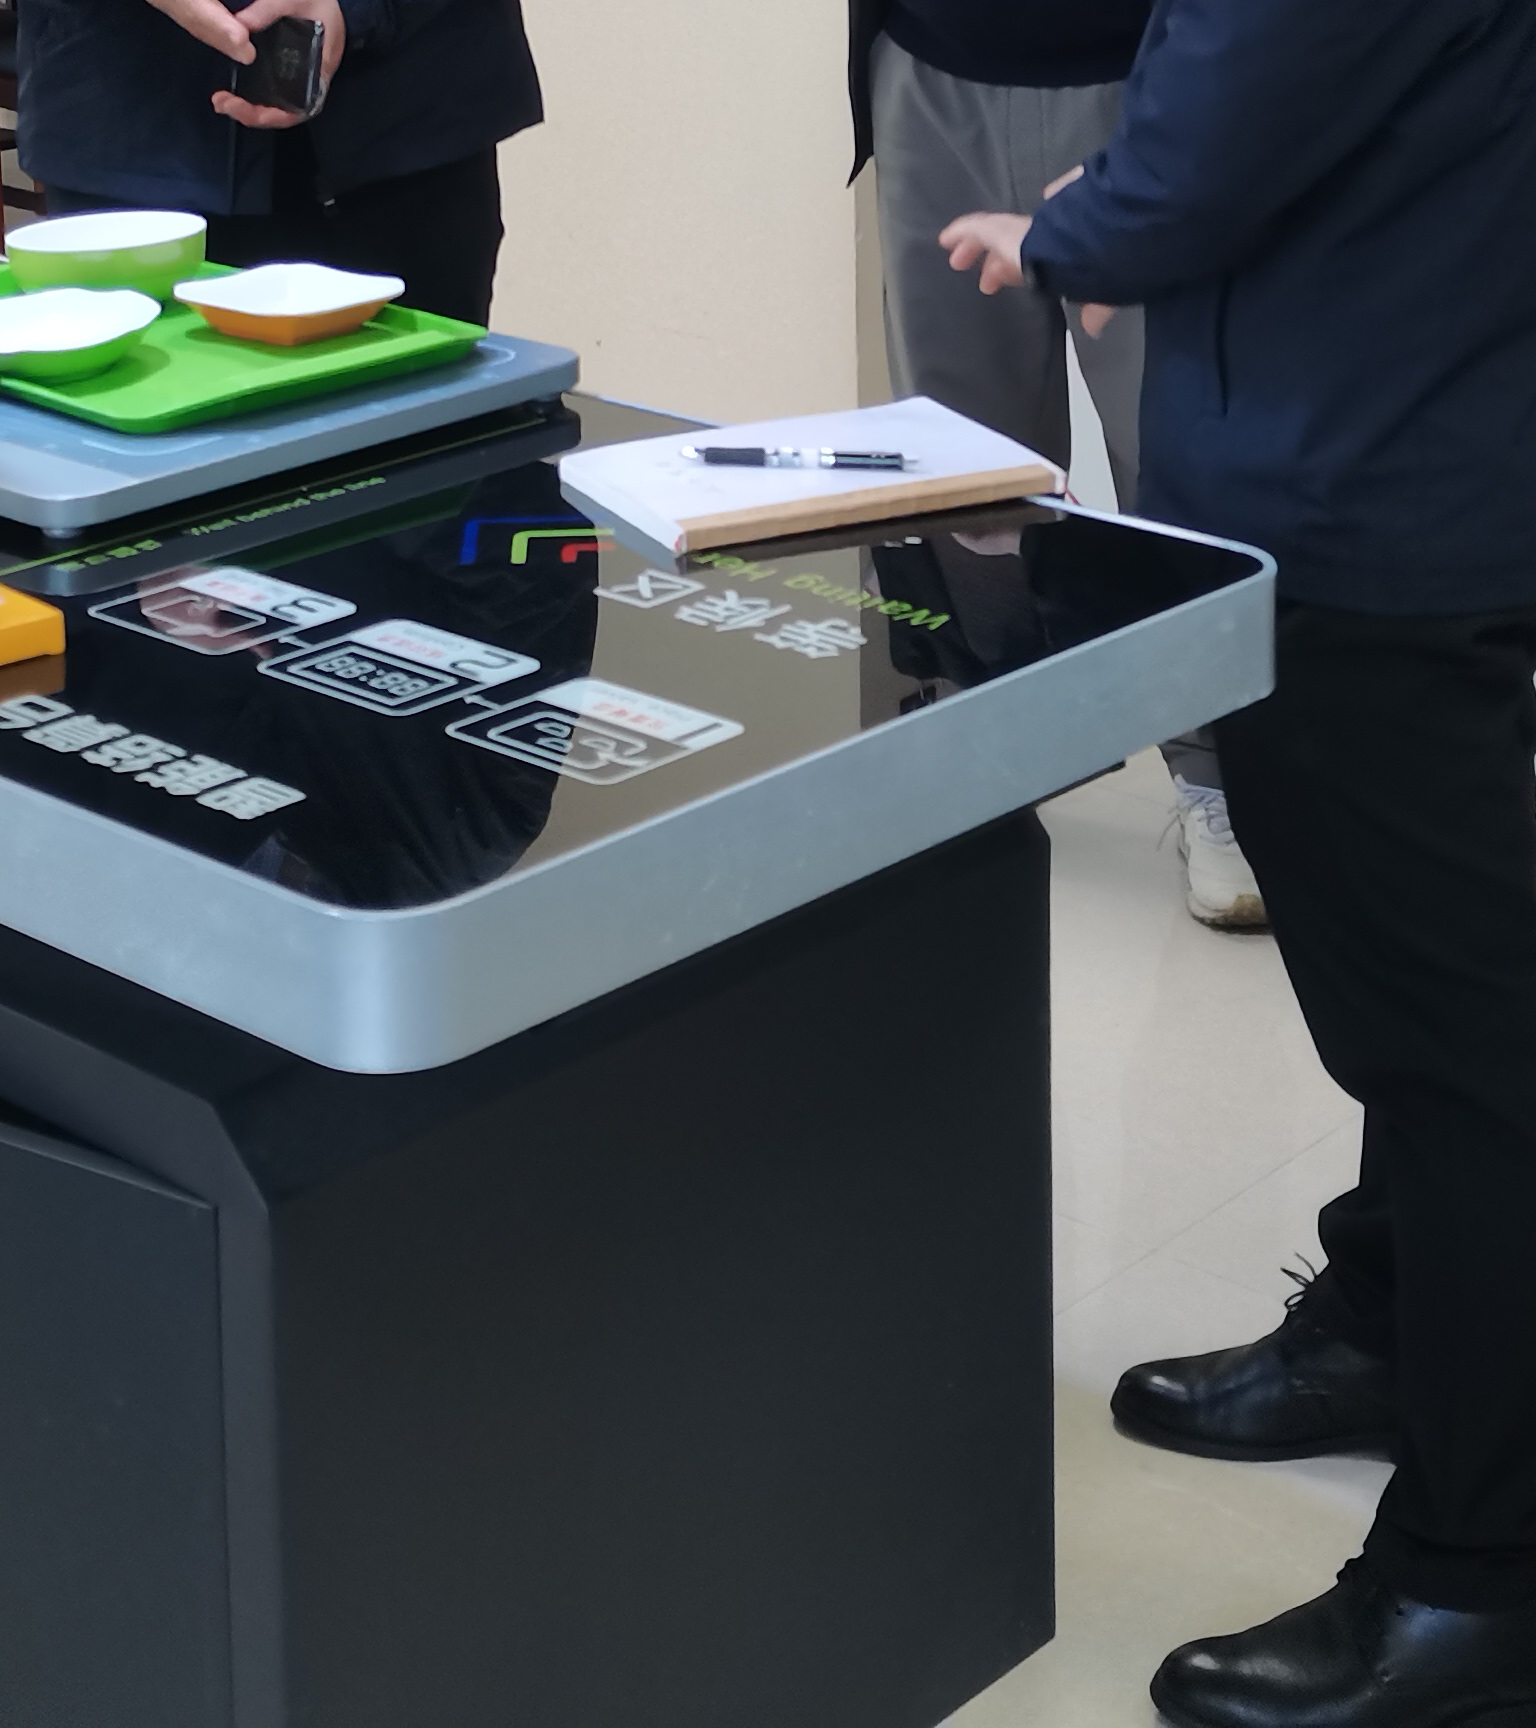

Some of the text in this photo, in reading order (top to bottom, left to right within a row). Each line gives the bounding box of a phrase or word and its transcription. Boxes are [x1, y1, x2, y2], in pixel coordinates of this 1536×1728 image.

[593, 568, 868, 658] 等候区
[448, 648, 520, 675] 2
